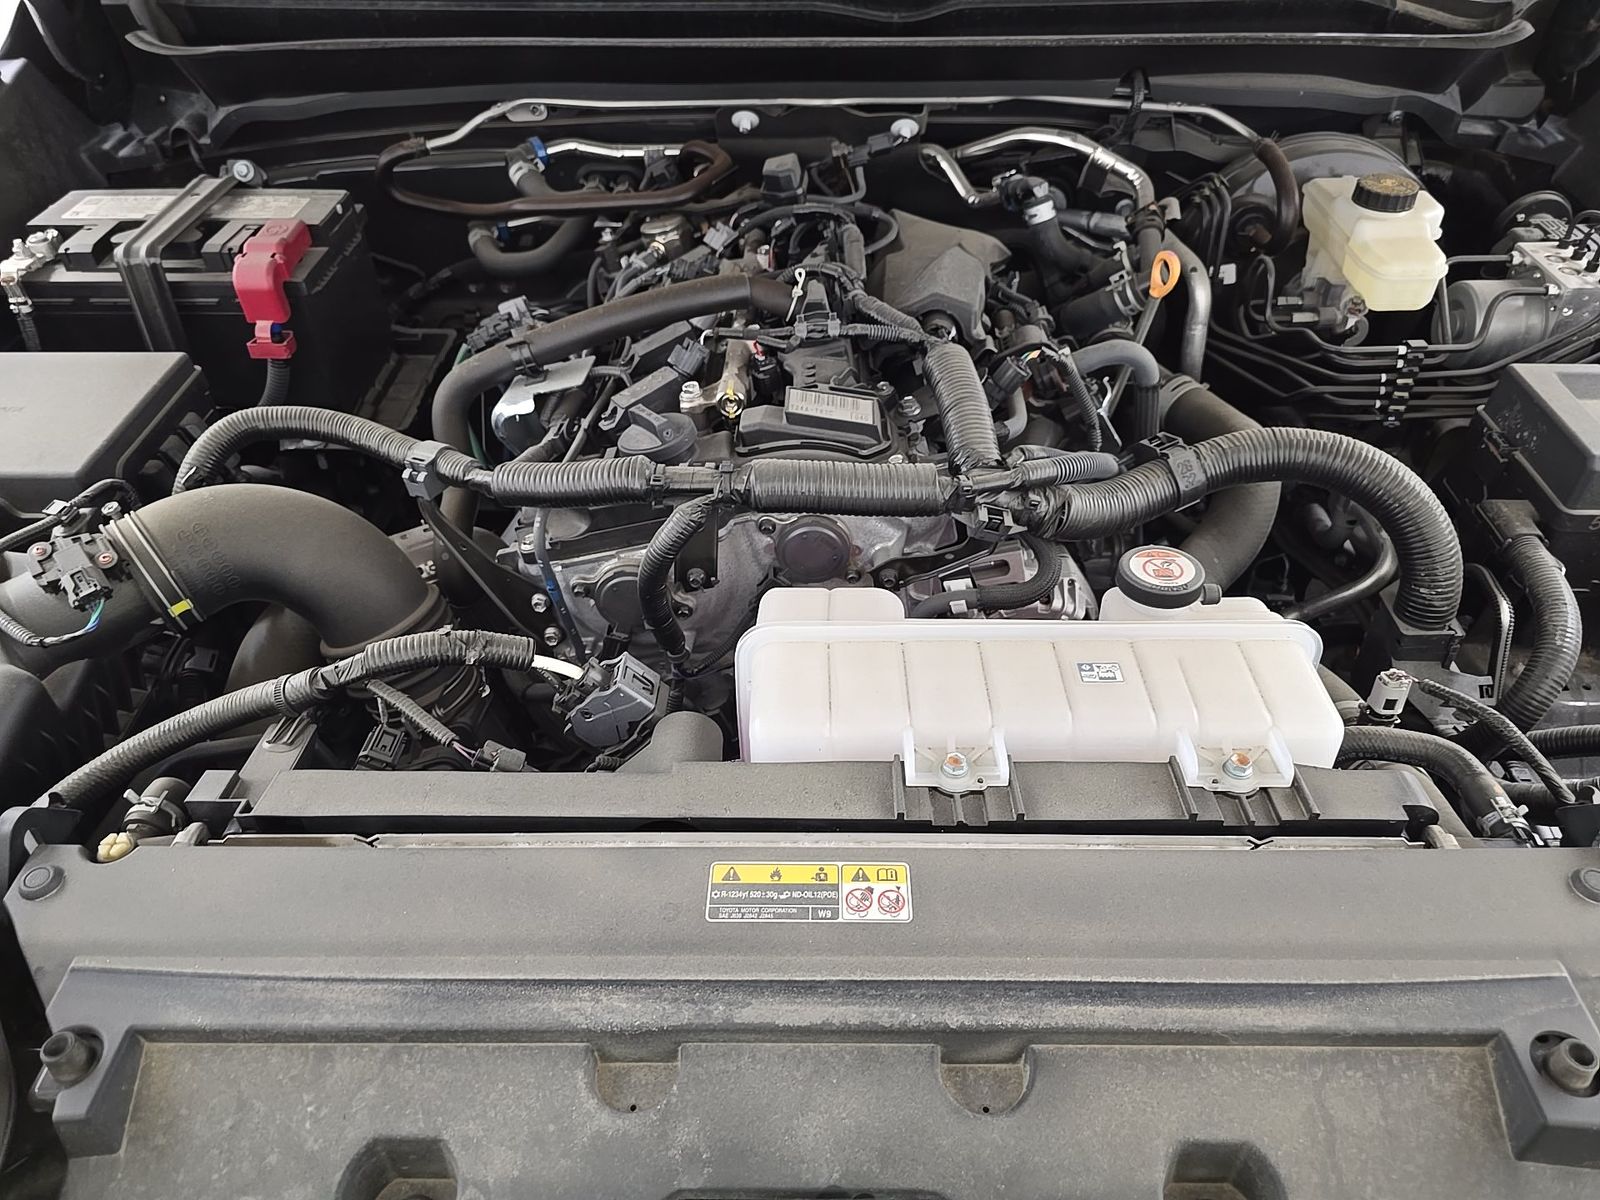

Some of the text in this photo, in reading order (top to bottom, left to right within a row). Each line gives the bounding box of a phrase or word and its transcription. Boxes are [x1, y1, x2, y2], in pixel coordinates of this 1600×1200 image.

[720, 890, 748, 900] R-1234yf
[791, 890, 839, 900] ND-OIL12(POE)
[817, 909, 832, 919] W9
